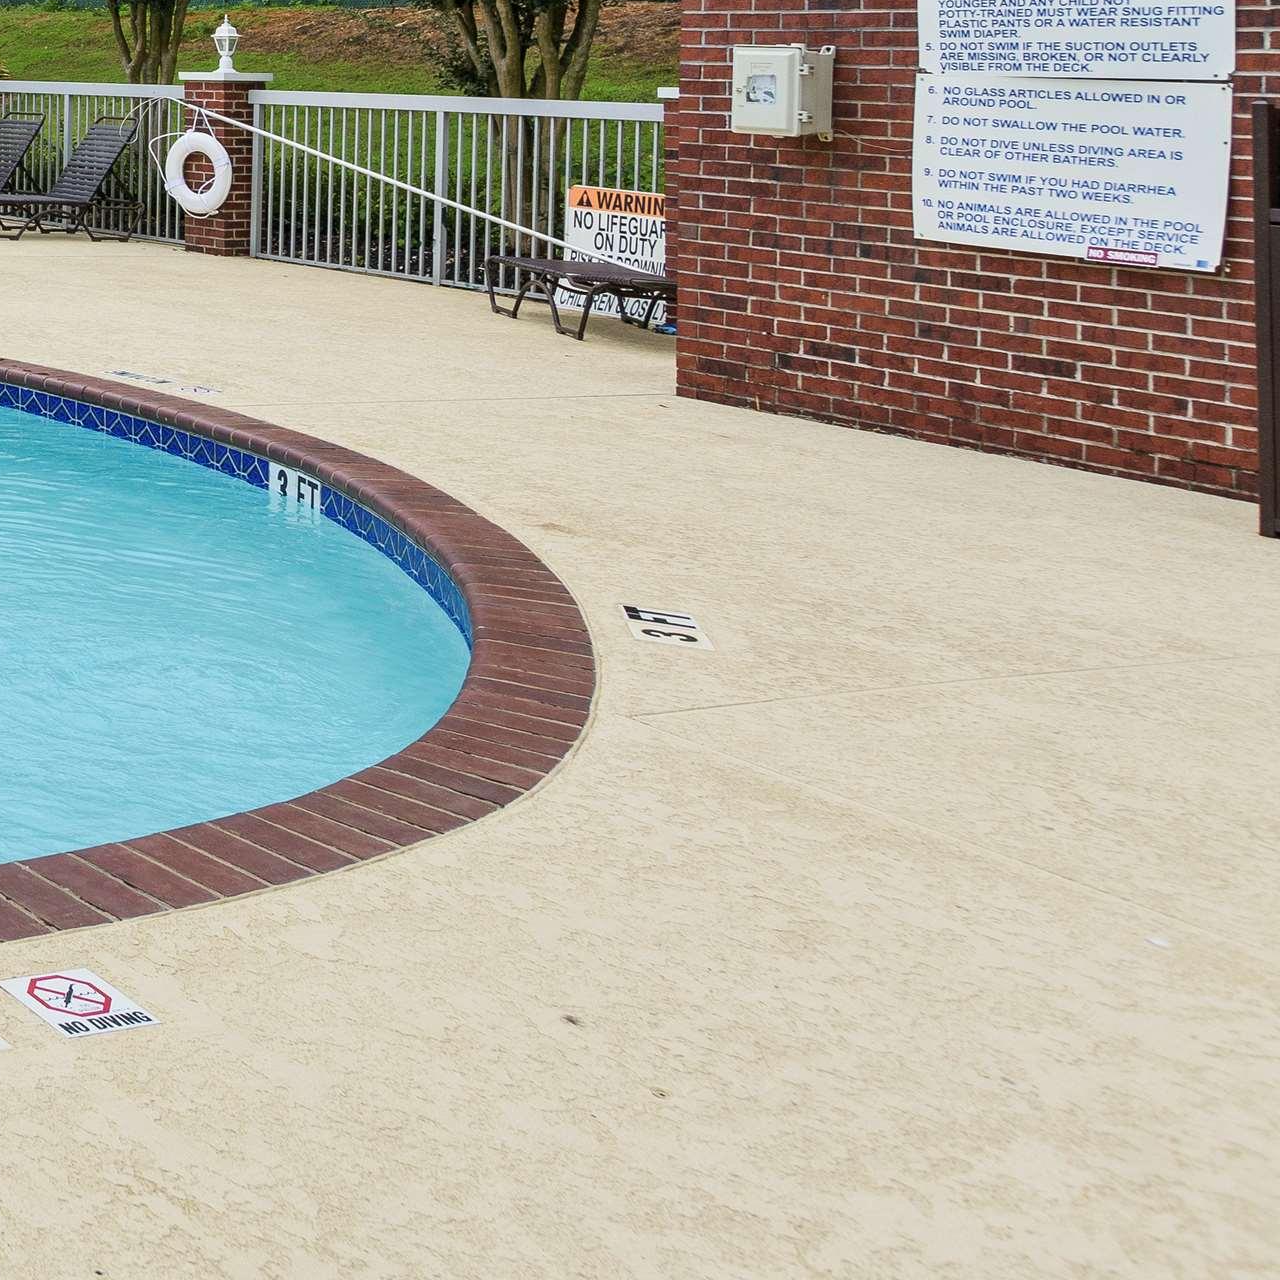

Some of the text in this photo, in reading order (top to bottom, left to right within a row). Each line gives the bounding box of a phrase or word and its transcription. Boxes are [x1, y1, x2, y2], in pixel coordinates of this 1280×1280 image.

[938, 6, 1224, 18] POTTY-TRAINED MUST WEAR SNUG FITTING
[939, 17, 1200, 28] PLASTIC PANTS OR A WATER RESISTANT
[939, 30, 970, 38] SWIM
[925, 42, 1197, 51] 5. DO NOT SWIM IF THE SUCTION OUTLETS
[940, 52, 963, 60] ARE
[1084, 52, 1103, 61] OR
[1108, 52, 1137, 61] NOT
[1141, 52, 1209, 62] CLEARLY
[940, 62, 984, 71] VISIBLE
[988, 62, 1022, 71] FROM
[1025, 62, 1049, 71] THE
[928, 85, 1186, 104] 6. NO GLASS ARTICLES ALLOWED IN OR
[942, 96, 995, 107] AROUND
[927, 115, 936, 123] 7.
[942, 116, 959, 125] DO
[963, 117, 988, 126] NOT
[992, 119, 1057, 130] SWALLOW
[1061, 122, 1087, 132] THE
[1090, 124, 1128, 134] POOL
[925, 135, 1183, 160] 8. DO NOT DIVE UNLESS DIVING AREA IS
[940, 146, 980, 158] CLEAR
[984, 149, 1000, 159] OF
[1004, 151, 1048, 162] OTHER
[924, 167, 1176, 196] 9. DO NOT SWIM IF YOU HAD DIARRHEA
[938, 179, 978, 190] WITHIN
[983, 182, 1006, 193] THE
[1011, 185, 1043, 196] PAST
[1047, 188, 1077, 199] TWO
[597, 191, 664, 217] WARNIN
[574, 210, 665, 239] NO LIFEGUAR
[922, 198, 1203, 233] 10. NO ANIMALS ARE ALLOWED IN THE POOL
[937, 210, 953, 219] OR
[957, 212, 990, 223] POOL
[1080, 224, 1133, 238] EXCEPT
[1137, 229, 1198, 244] SERVICE
[938, 220, 988, 234] ANIMALS
[991, 226, 1017, 237] ARE
[1020, 228, 1085, 244] ALLOWED
[1089, 236, 1108, 246] ON
[1113, 238, 1139, 249] THE
[594, 232, 657, 258] ON DUTY
[1089, 249, 1156, 264] NO SMOKING
[297, 475, 319, 510] FT
[623, 605, 698, 642] 3 FT
[58, 1011, 152, 1035] NO DIVING
